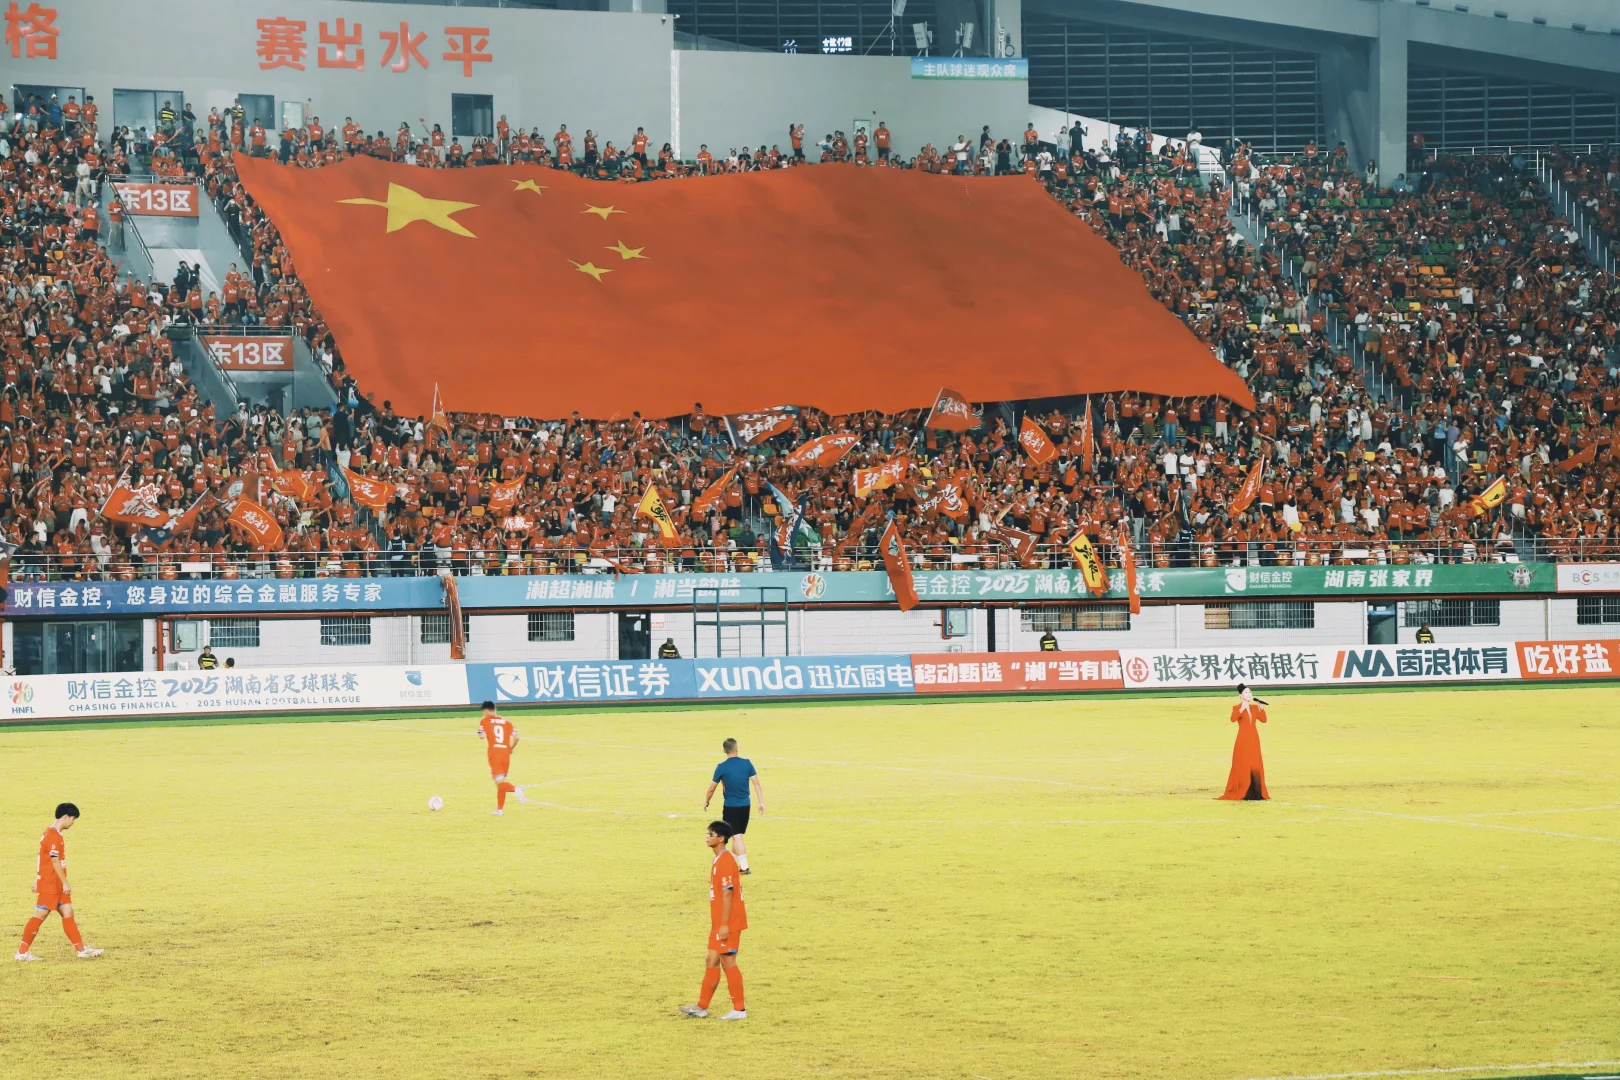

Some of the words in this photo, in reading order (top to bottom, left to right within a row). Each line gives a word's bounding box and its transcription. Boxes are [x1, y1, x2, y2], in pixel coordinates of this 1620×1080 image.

[4, 2, 61, 60] 格
[256, 17, 493, 77] 赛出水平
[924, 63, 1017, 77] 主队球迷观众席
[118, 186, 191, 212] 东13区
[208, 340, 285, 366] 东13区
[526, 579, 615, 600] 湘超湘味
[653, 577, 741, 599] 湘当韵味
[976, 574, 1031, 595] 2025
[1249, 571, 1292, 583] 财信金控
[1324, 569, 1433, 588] 湖南张家界
[1573, 572, 1600, 583] BCS
[1153, 652, 1320, 682] 张家界农商银行
[1396, 646, 1508, 676] 茵浪体育
[1524, 643, 1613, 676] 吃好盐
[67, 678, 158, 701] 财信金控
[161, 676, 219, 697] 2025
[224, 672, 359, 695] 湖南省足球联赛
[533, 663, 671, 699] 财信证券
[697, 658, 804, 693] xunda
[808, 663, 914, 690] 迅达厨电
[12, 706, 35, 714] HNFL
[69, 703, 117, 712] CHASING
[121, 701, 178, 710] FINANCIAL
[197, 699, 222, 707] 2025
[225, 698, 261, 706] HUNAN
[265, 697, 318, 705] FOOTBALL
[323, 695, 361, 704] LEAGUE
[493, 725, 504, 743] 9
